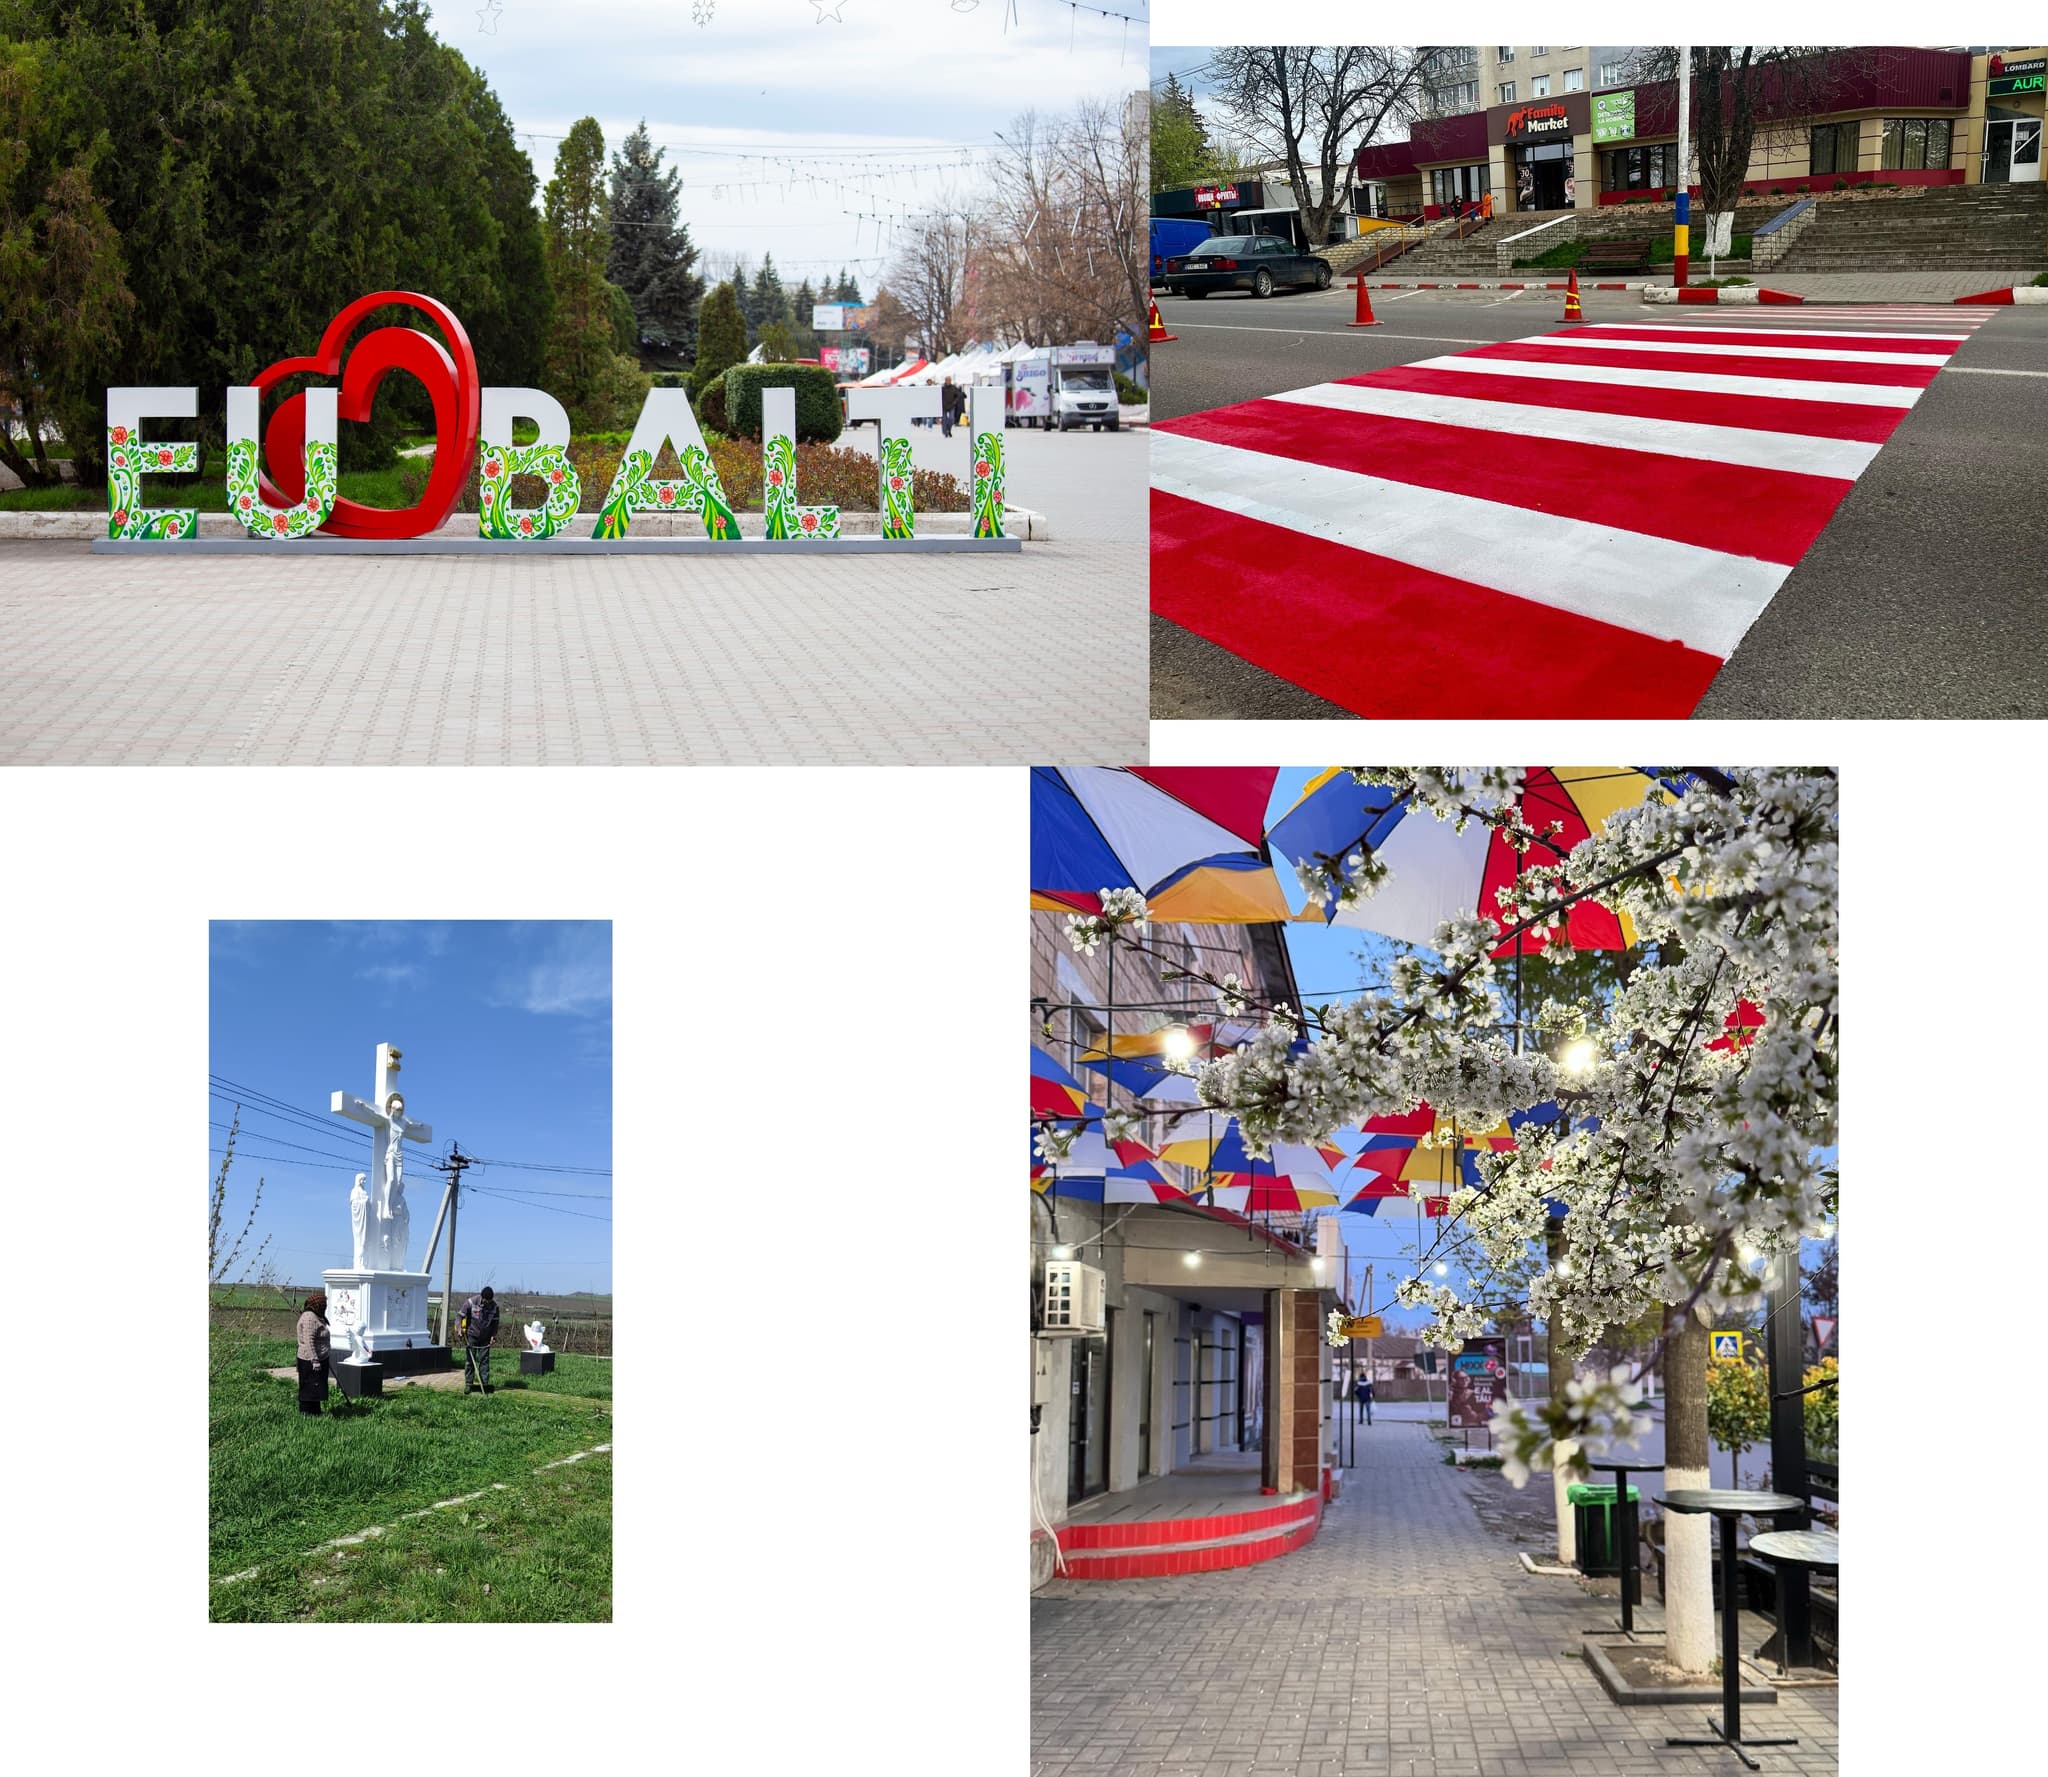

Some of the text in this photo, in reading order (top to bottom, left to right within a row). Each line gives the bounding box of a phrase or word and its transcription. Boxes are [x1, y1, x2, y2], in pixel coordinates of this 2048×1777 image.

[2004, 62, 2045, 72] LOMBARD
[2012, 76, 2044, 90] AUR
[1527, 103, 1567, 120] Family
[1527, 117, 1569, 133] Market
[107, 386, 1006, 539] EU BALTI
